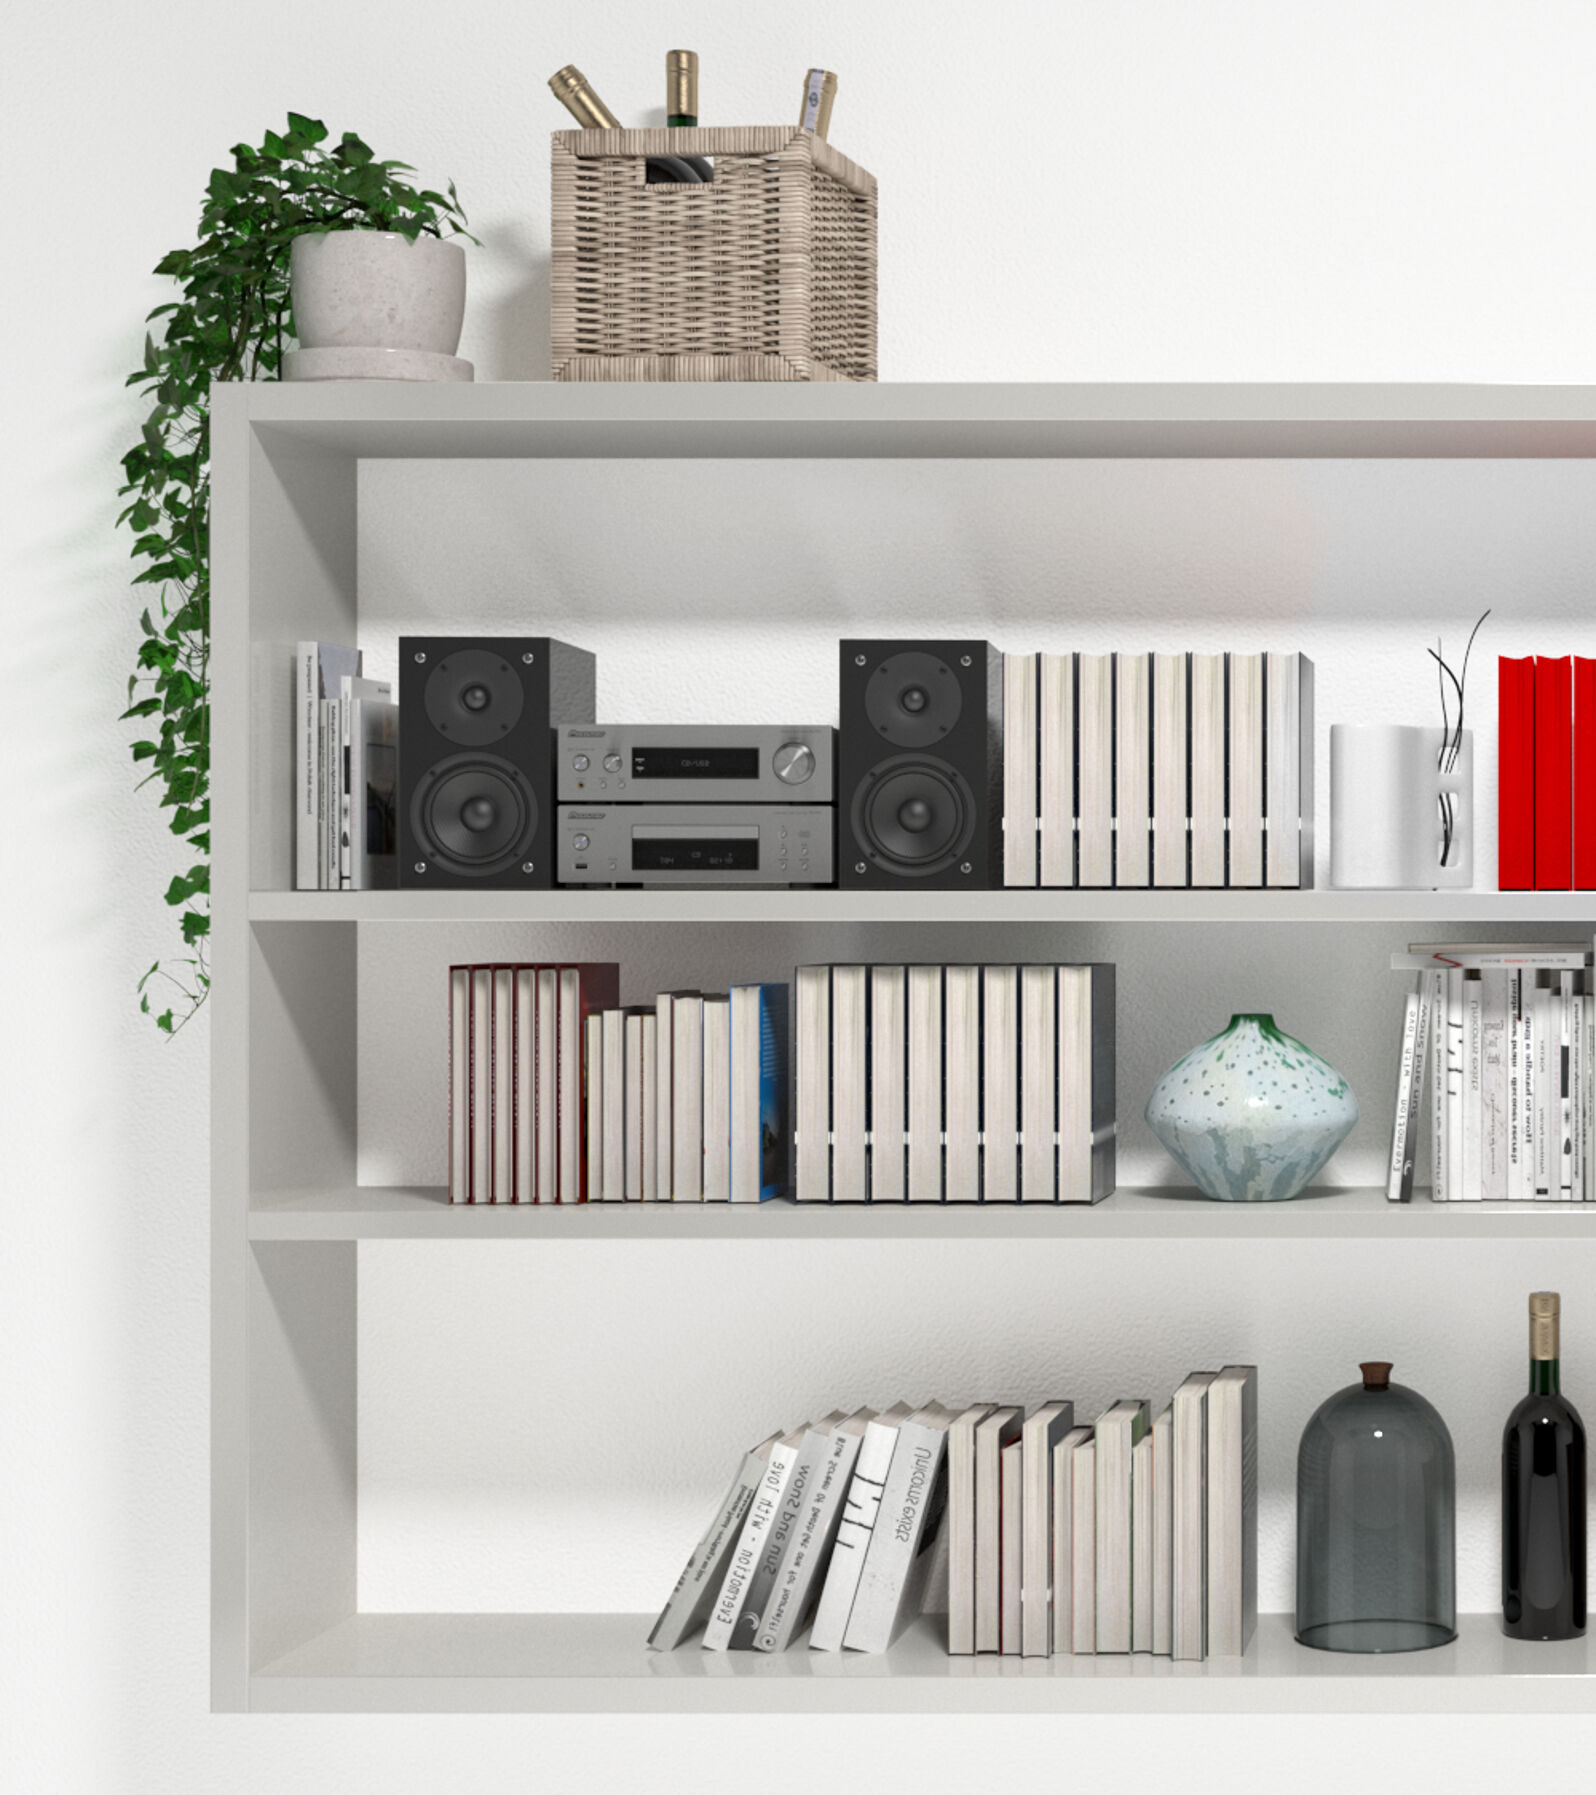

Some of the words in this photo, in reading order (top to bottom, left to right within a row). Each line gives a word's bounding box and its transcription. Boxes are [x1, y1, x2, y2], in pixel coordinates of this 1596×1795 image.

[1407, 1010, 1417, 1036] love
[1418, 1003, 1428, 1049] Snow
[1404, 1044, 1413, 1078] with
[1414, 1054, 1424, 1084] and
[1410, 1089, 1420, 1120] Sun
[1393, 1098, 1408, 1174] Evermotion
